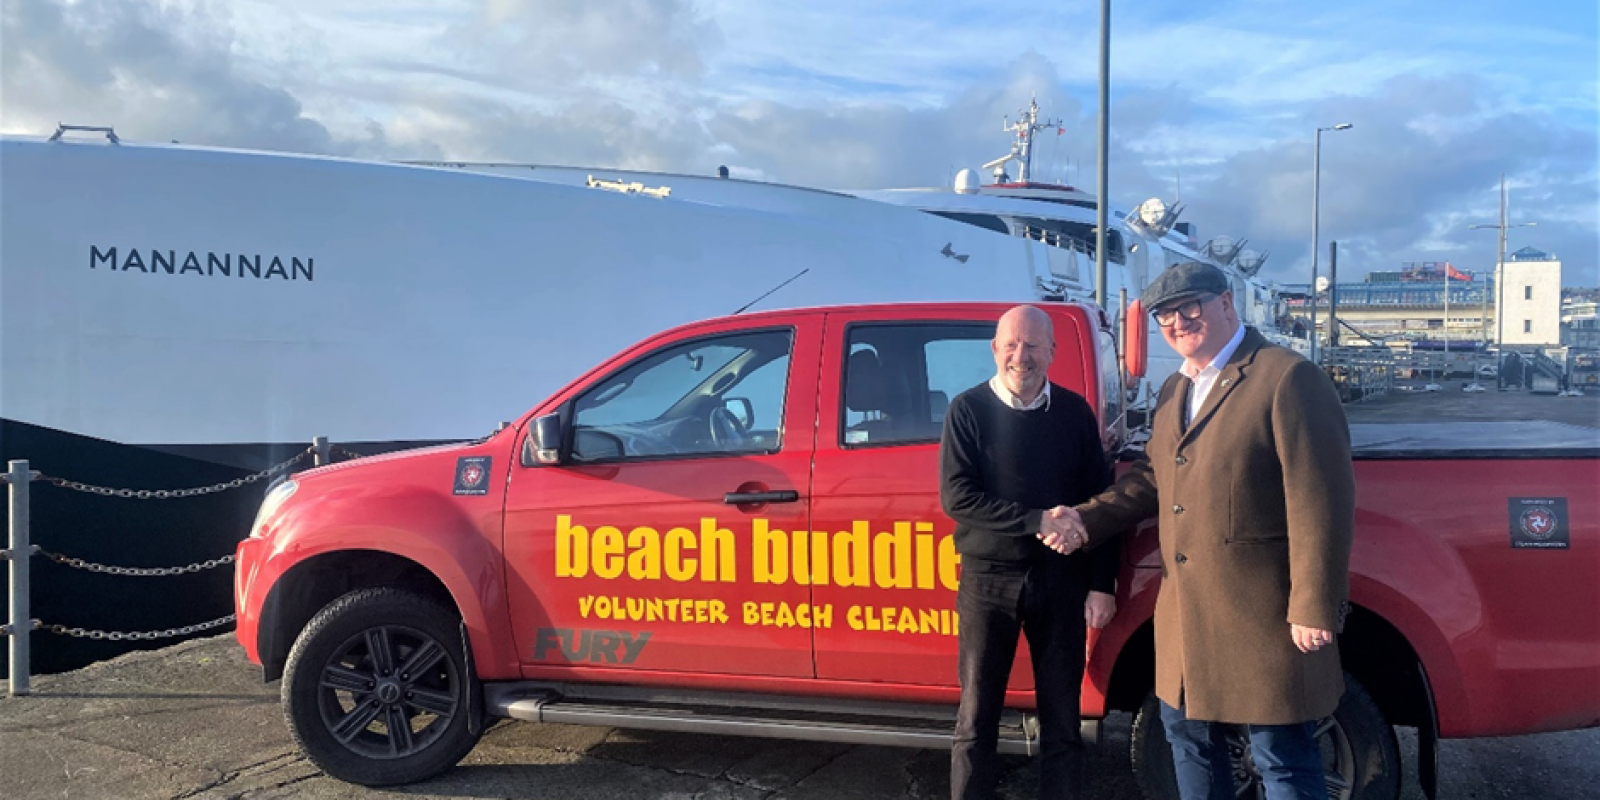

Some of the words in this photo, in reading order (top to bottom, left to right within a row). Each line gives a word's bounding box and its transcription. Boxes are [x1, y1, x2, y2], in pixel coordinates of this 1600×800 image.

[89, 244, 314, 281] MANANNAN
[555, 515, 736, 583] beach
[578, 595, 728, 625] VOLUNTEER
[743, 601, 832, 631] BEACH
[534, 628, 651, 666] FURY
